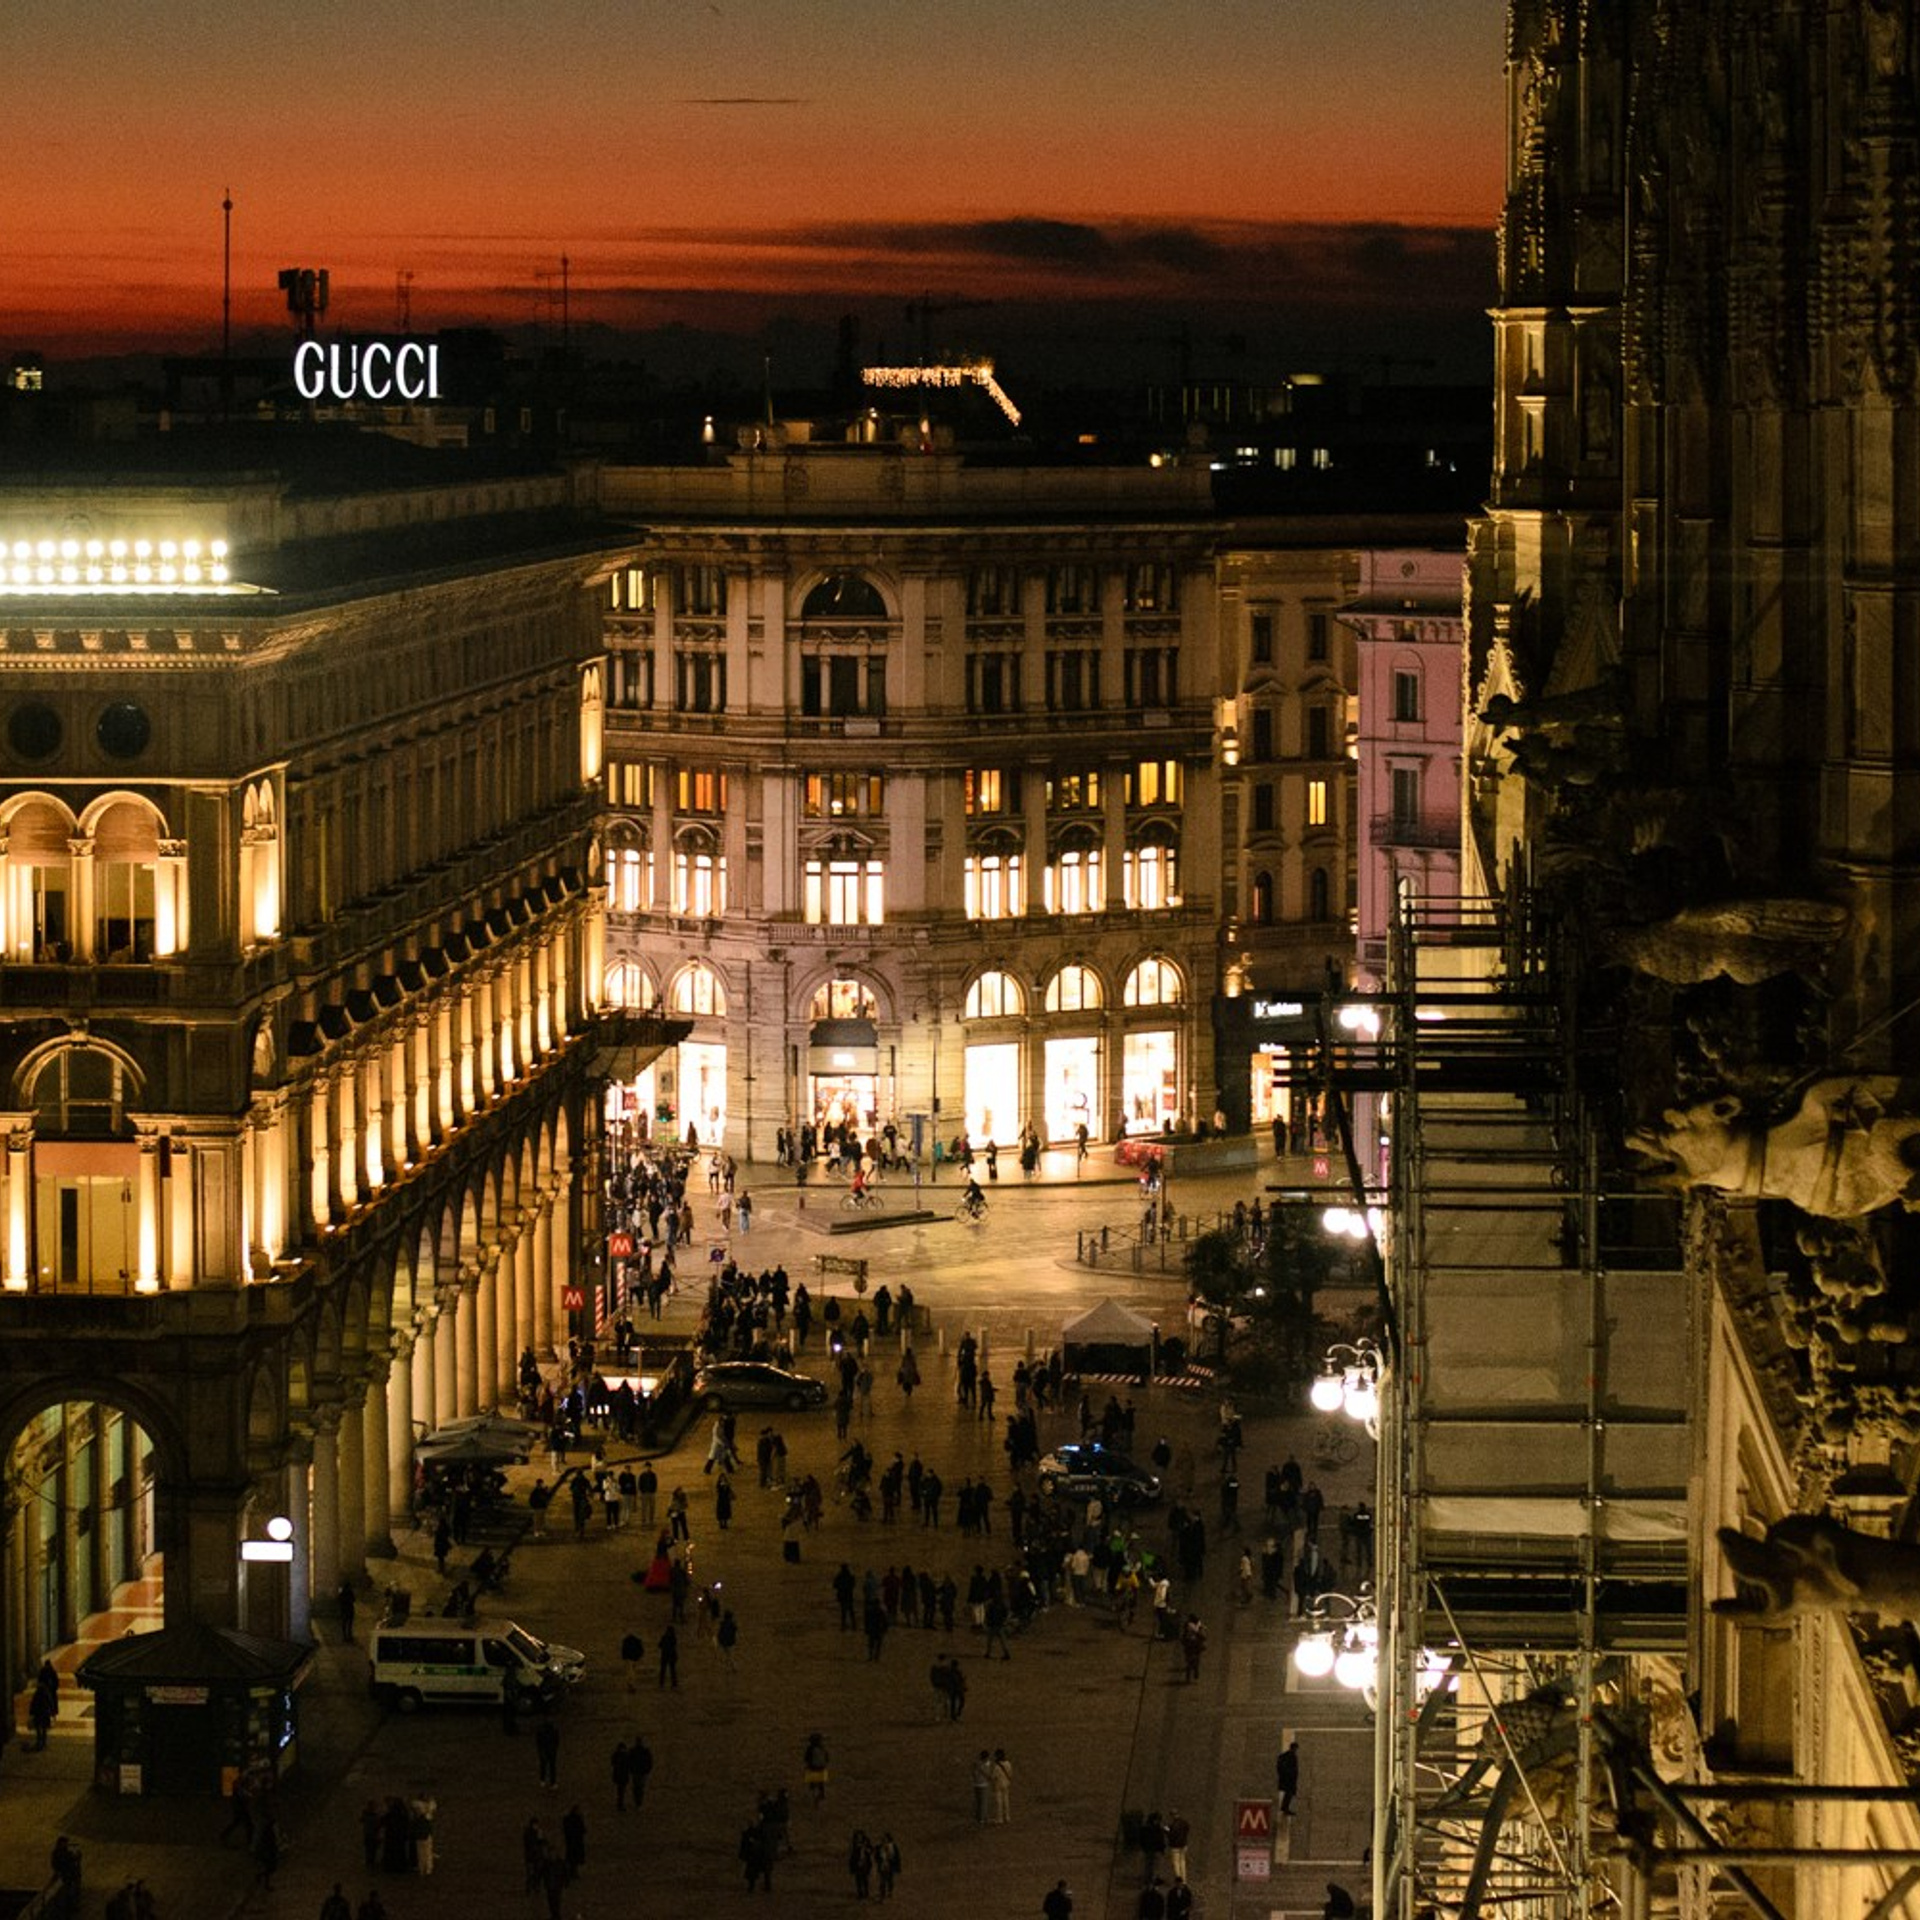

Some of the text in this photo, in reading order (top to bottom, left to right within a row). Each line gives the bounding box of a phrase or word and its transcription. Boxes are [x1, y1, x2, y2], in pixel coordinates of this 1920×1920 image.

[294, 341, 439, 399] GUCCI
[1315, 1162, 1328, 1174] M
[613, 1239, 631, 1252] M
[565, 1292, 583, 1305] M
[1241, 1809, 1268, 1830] M
